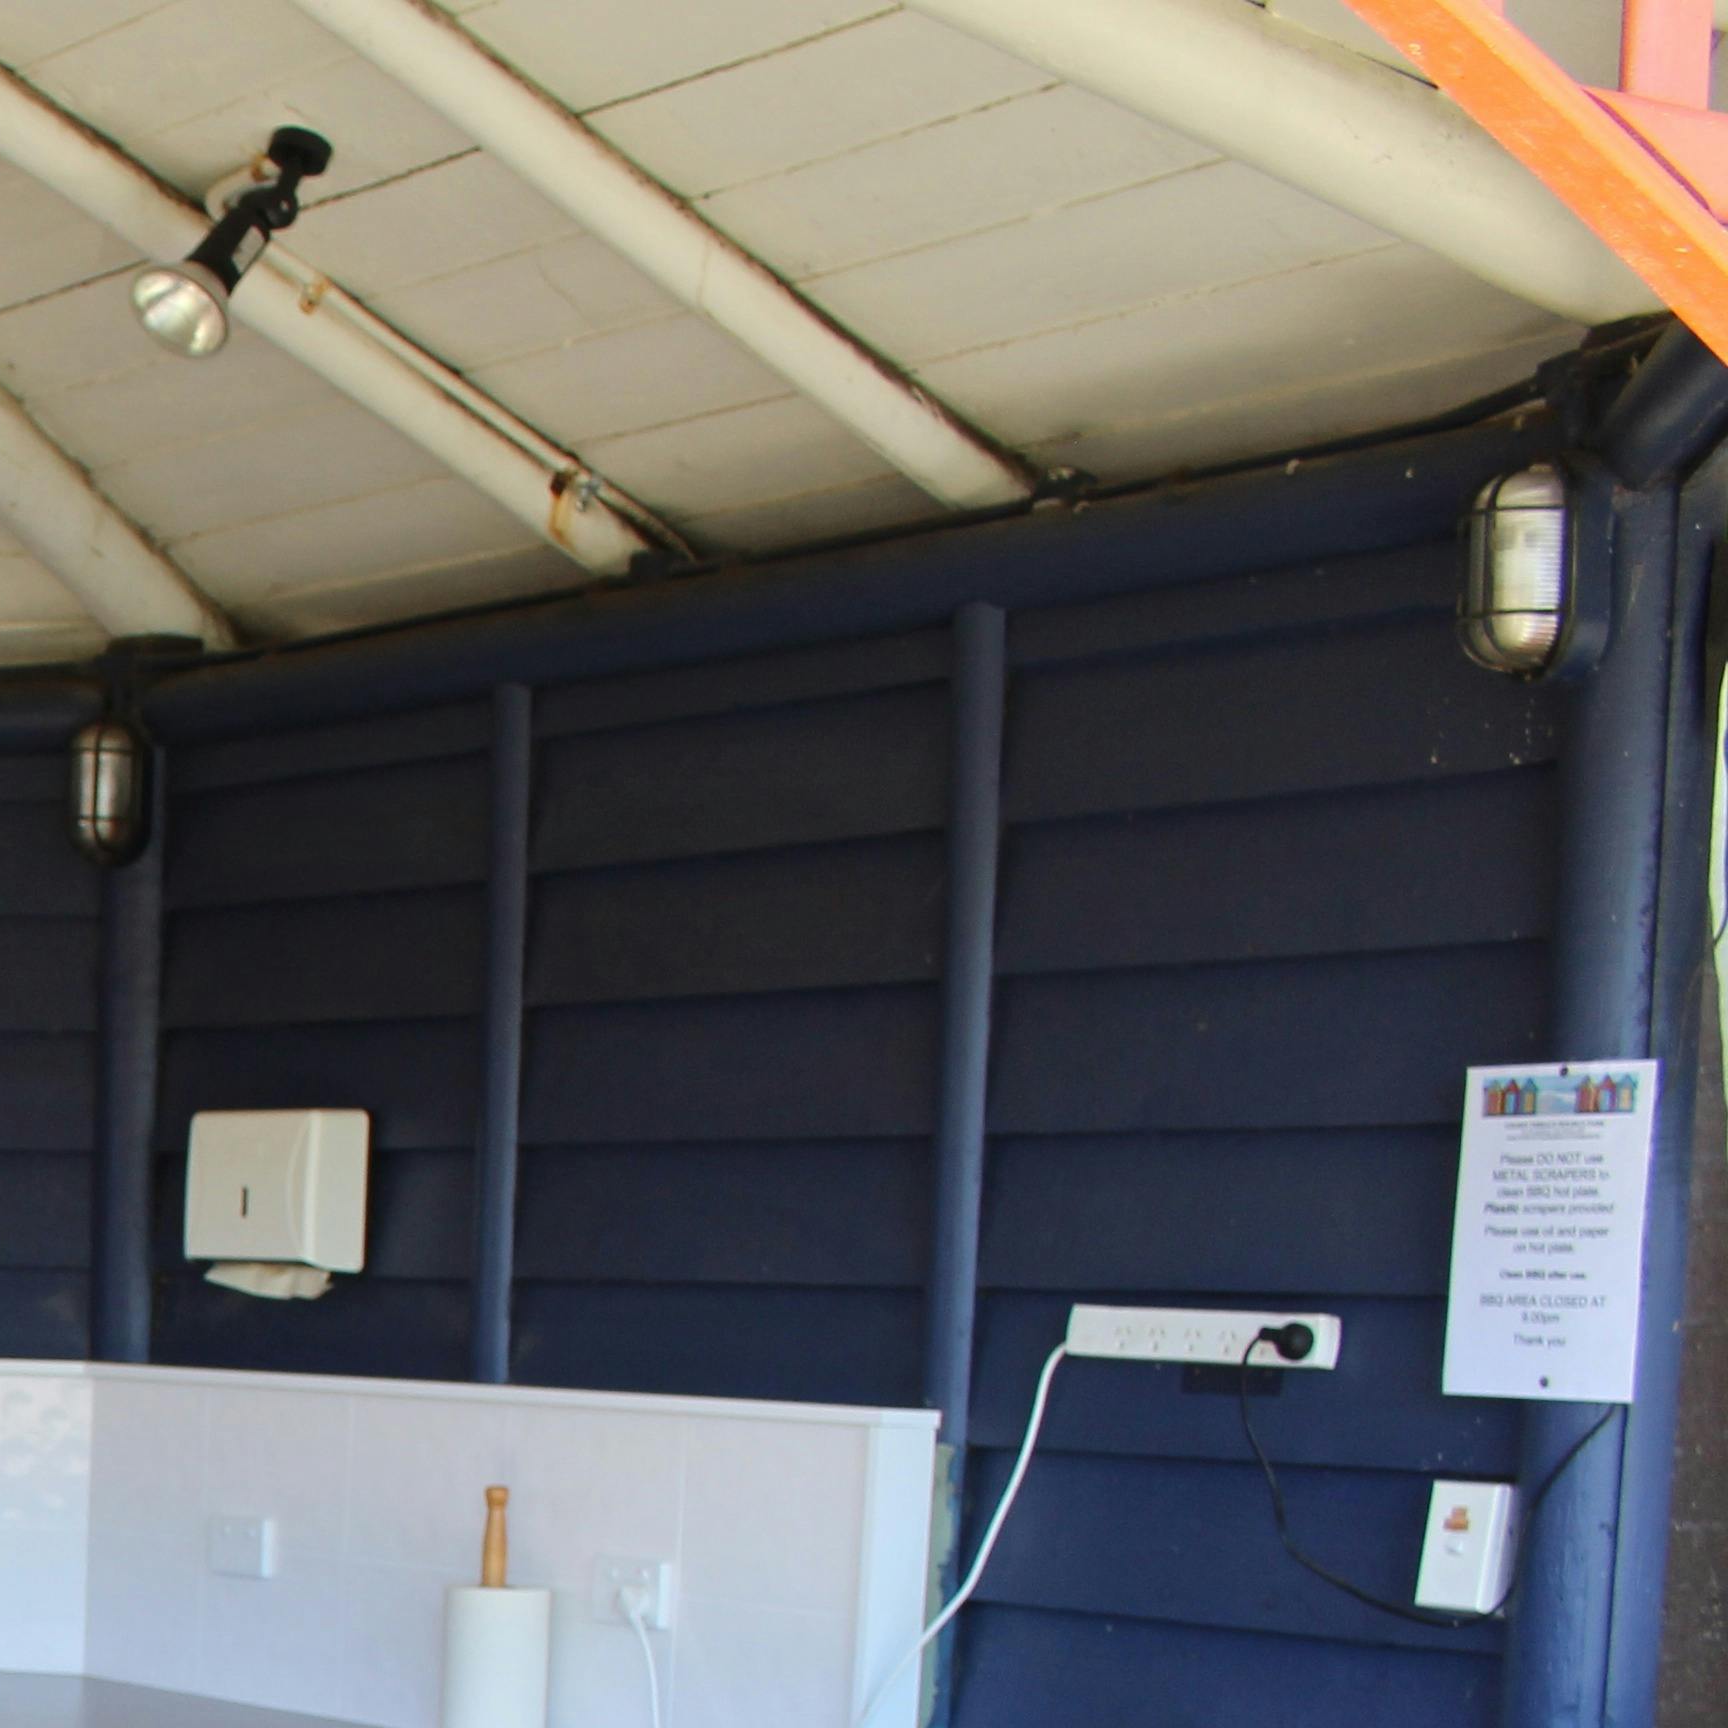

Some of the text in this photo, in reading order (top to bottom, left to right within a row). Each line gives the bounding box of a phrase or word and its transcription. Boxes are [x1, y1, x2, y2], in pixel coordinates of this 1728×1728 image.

[1536, 1152, 1555, 1165] DO
[1557, 1152, 1582, 1165] NOT
[1492, 1169, 1529, 1181] METAL
[1534, 1168, 1597, 1181] SCRAPERS
[1480, 1294, 1607, 1308] BBQ AREA CLOSED AT
[1514, 1332, 1543, 1345] Thank
